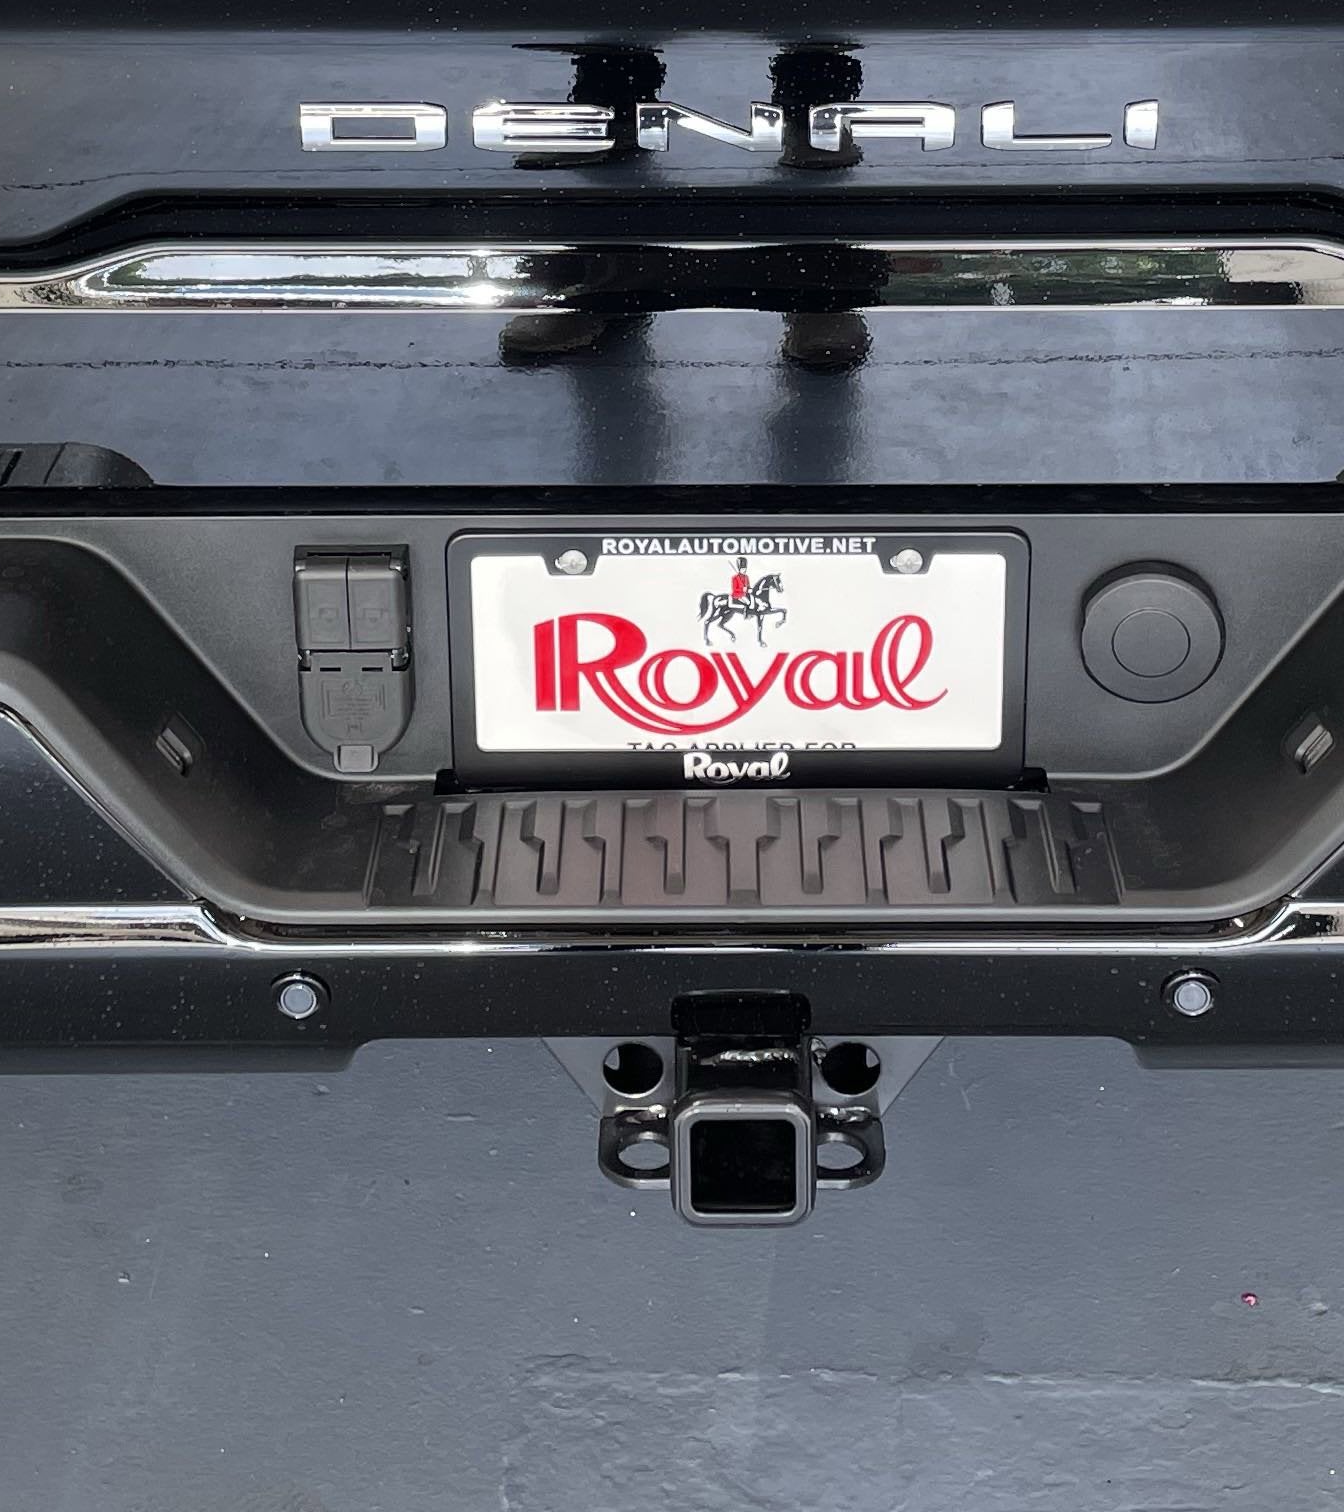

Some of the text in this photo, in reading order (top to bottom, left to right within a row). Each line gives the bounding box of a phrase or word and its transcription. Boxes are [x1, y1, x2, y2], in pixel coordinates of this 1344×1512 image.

[299, 98, 1159, 152] DENALI
[601, 537, 877, 555] ROYALAUTOMOTIVE.NET
[533, 613, 948, 736] Royal
[682, 751, 791, 785] Royal
